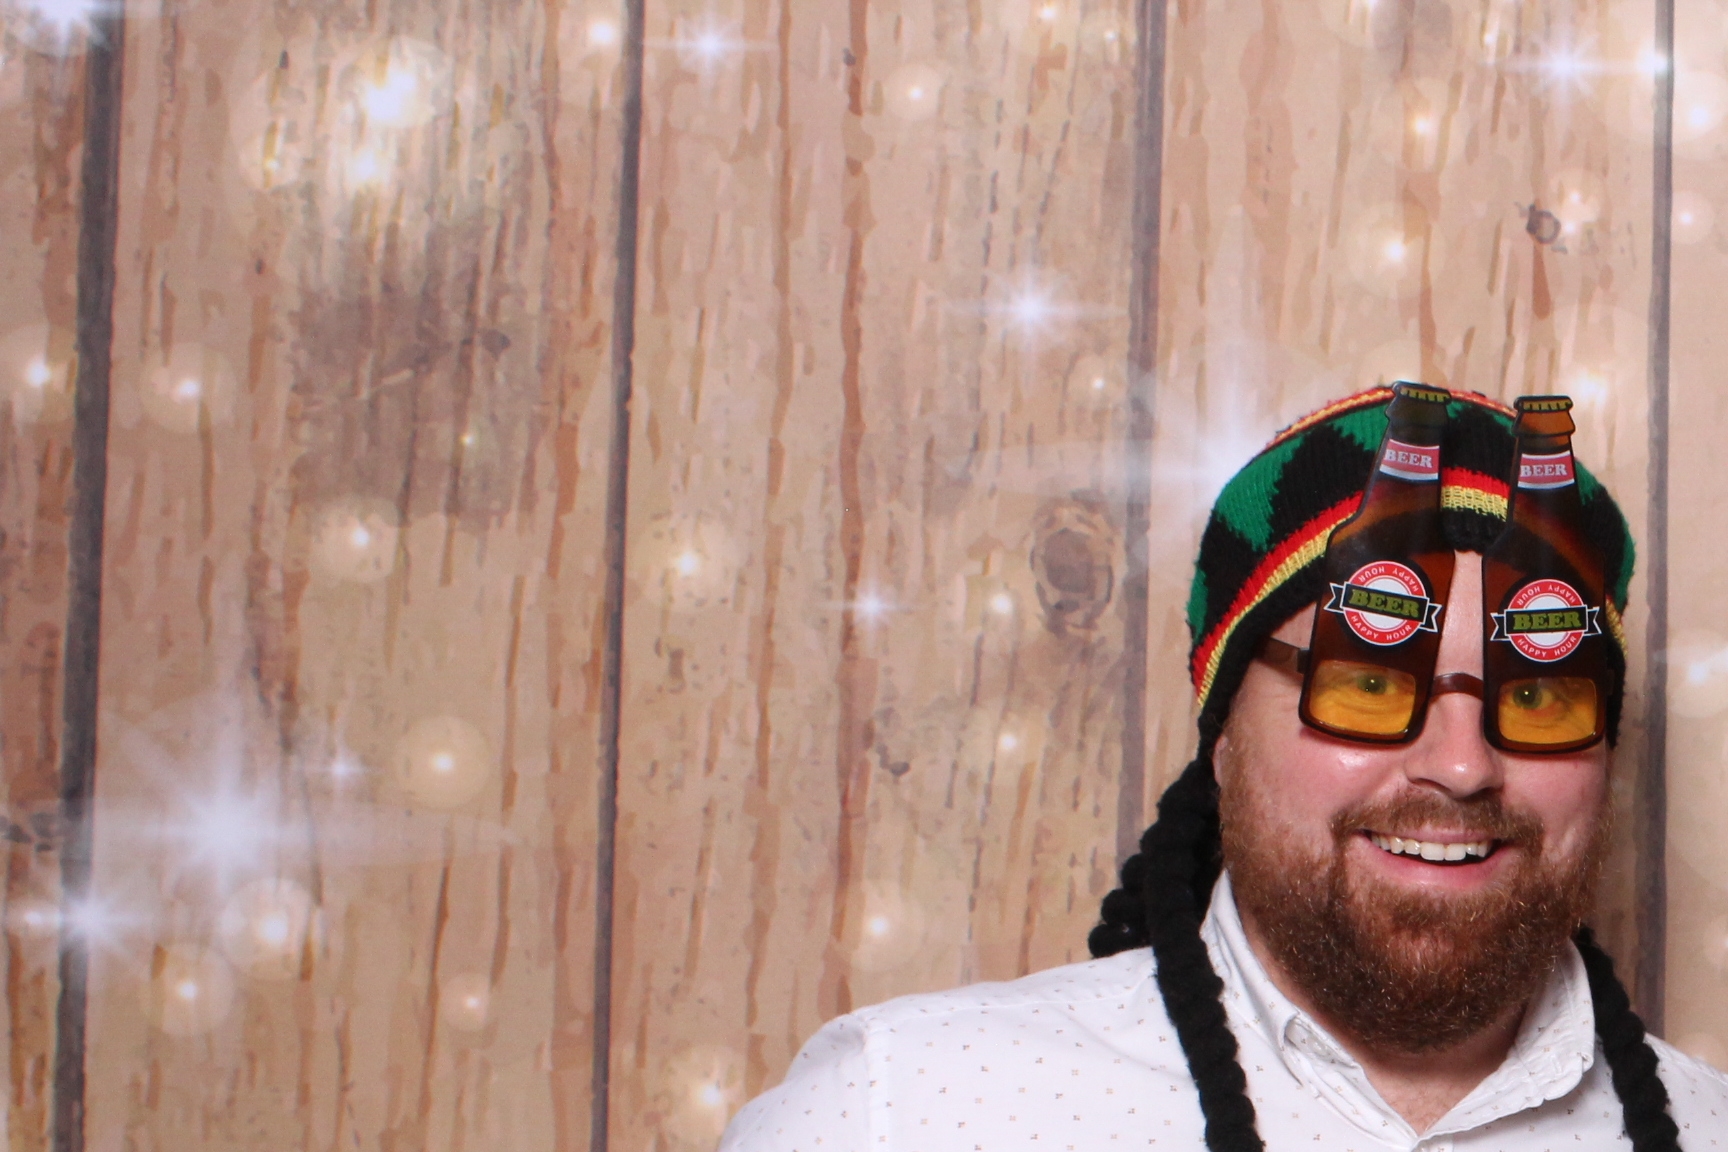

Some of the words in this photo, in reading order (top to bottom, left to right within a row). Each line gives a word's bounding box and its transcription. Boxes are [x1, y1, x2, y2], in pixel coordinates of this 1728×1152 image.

[1384, 449, 1433, 469] BEER
[1520, 463, 1568, 478] BEER
[1358, 566, 1385, 583] HOUR
[1392, 568, 1419, 592] HAPPY
[1349, 589, 1420, 618] BEER
[1517, 586, 1540, 606] HOUR
[1548, 584, 1576, 603] HAPPY
[1351, 615, 1379, 639] HAPPY
[1386, 624, 1412, 641] HOUR
[1513, 611, 1582, 630] BEER
[1517, 638, 1547, 658] HAPPY
[1554, 636, 1577, 656] HOUR
